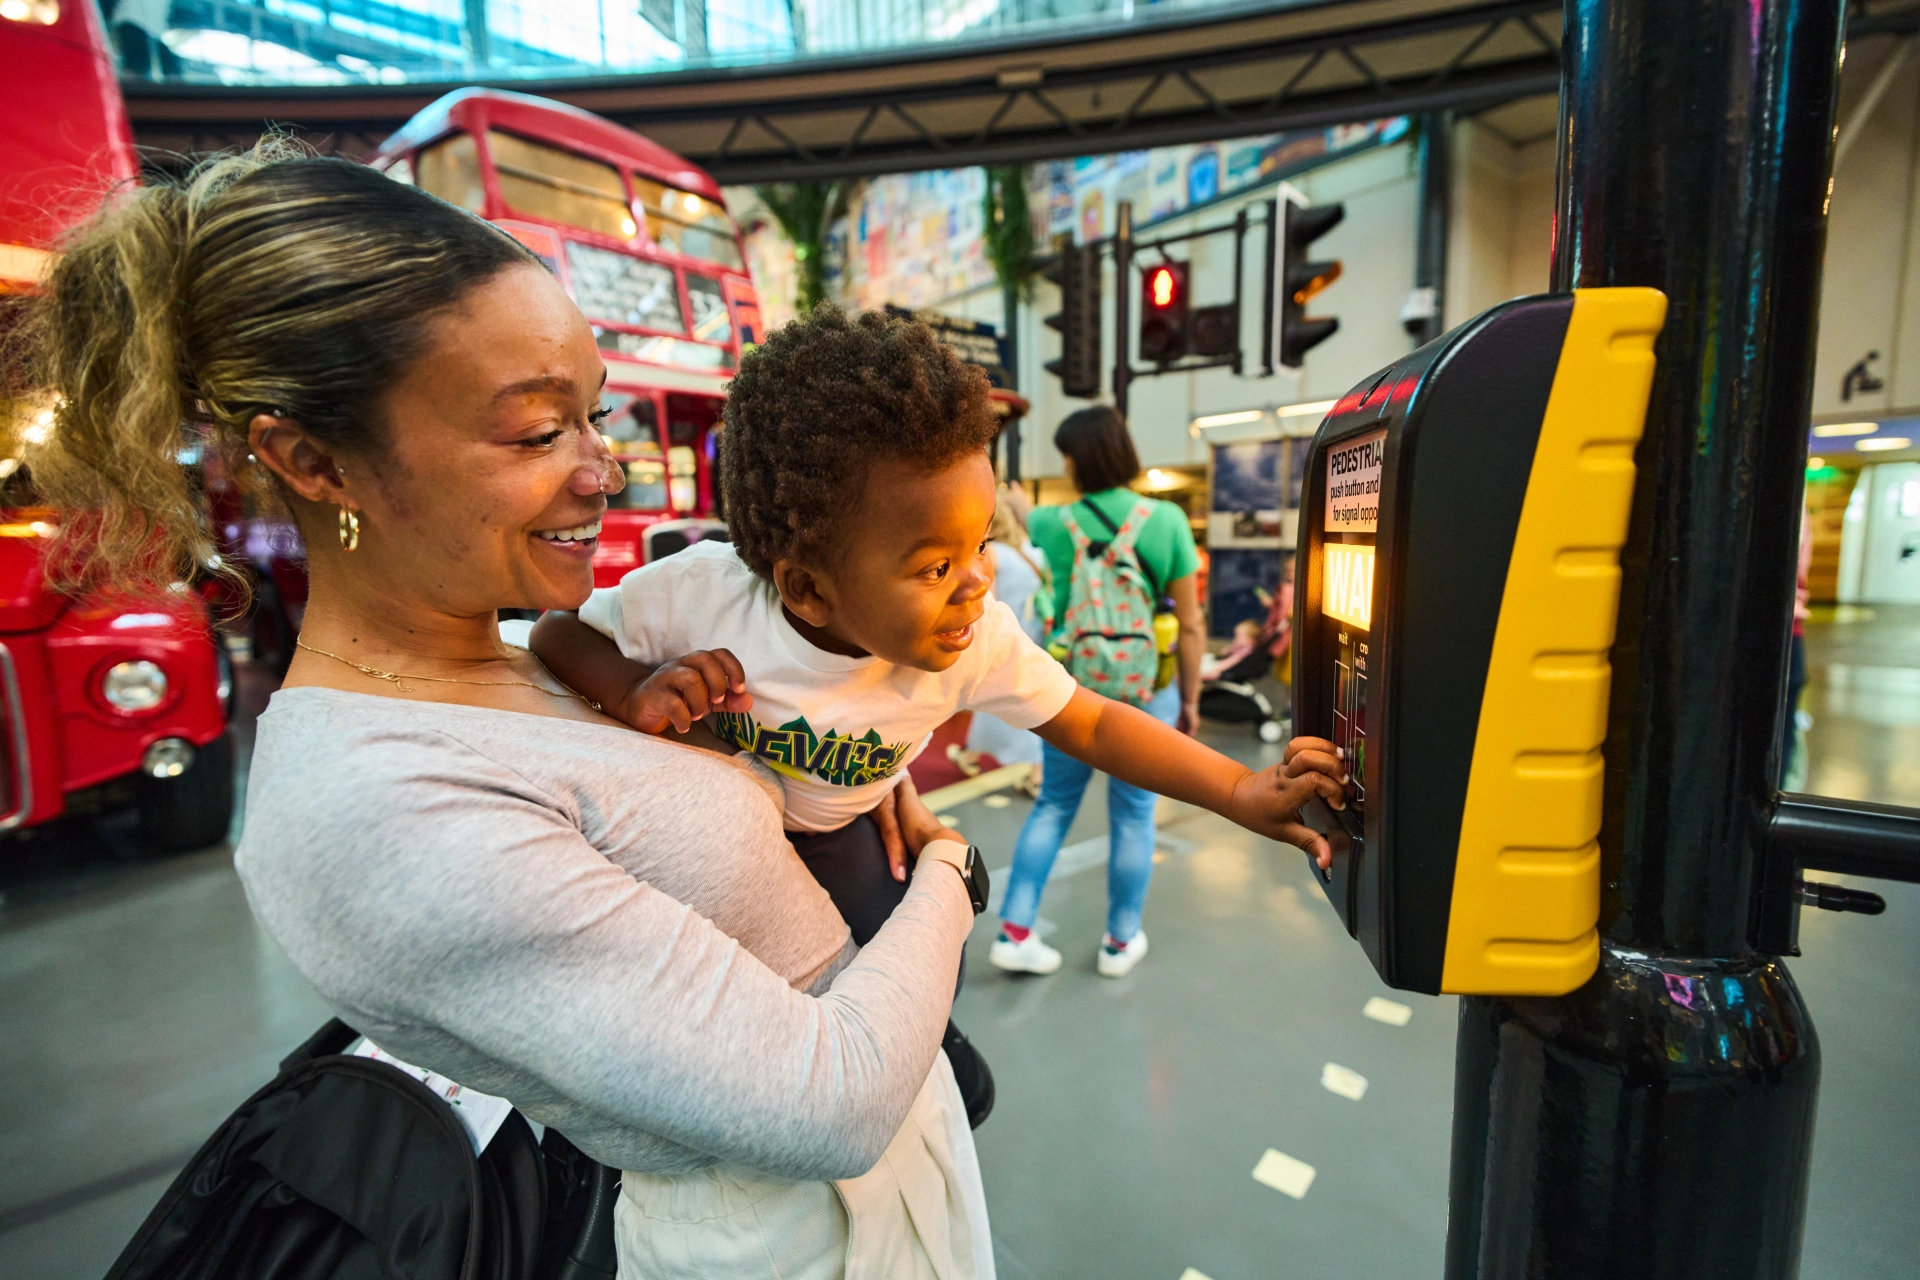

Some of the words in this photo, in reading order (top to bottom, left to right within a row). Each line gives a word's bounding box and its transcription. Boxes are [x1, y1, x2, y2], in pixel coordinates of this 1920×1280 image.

[1331, 440, 1382, 476] PEDESTRIA
[1331, 481, 1343, 502] push
[1345, 479, 1364, 497] button
[1366, 474, 1379, 494] and
[1333, 505, 1341, 521] for
[1342, 503, 1359, 525] signal
[1361, 507, 1377, 524] oppo
[724, 721, 899, 786] EVI'S
